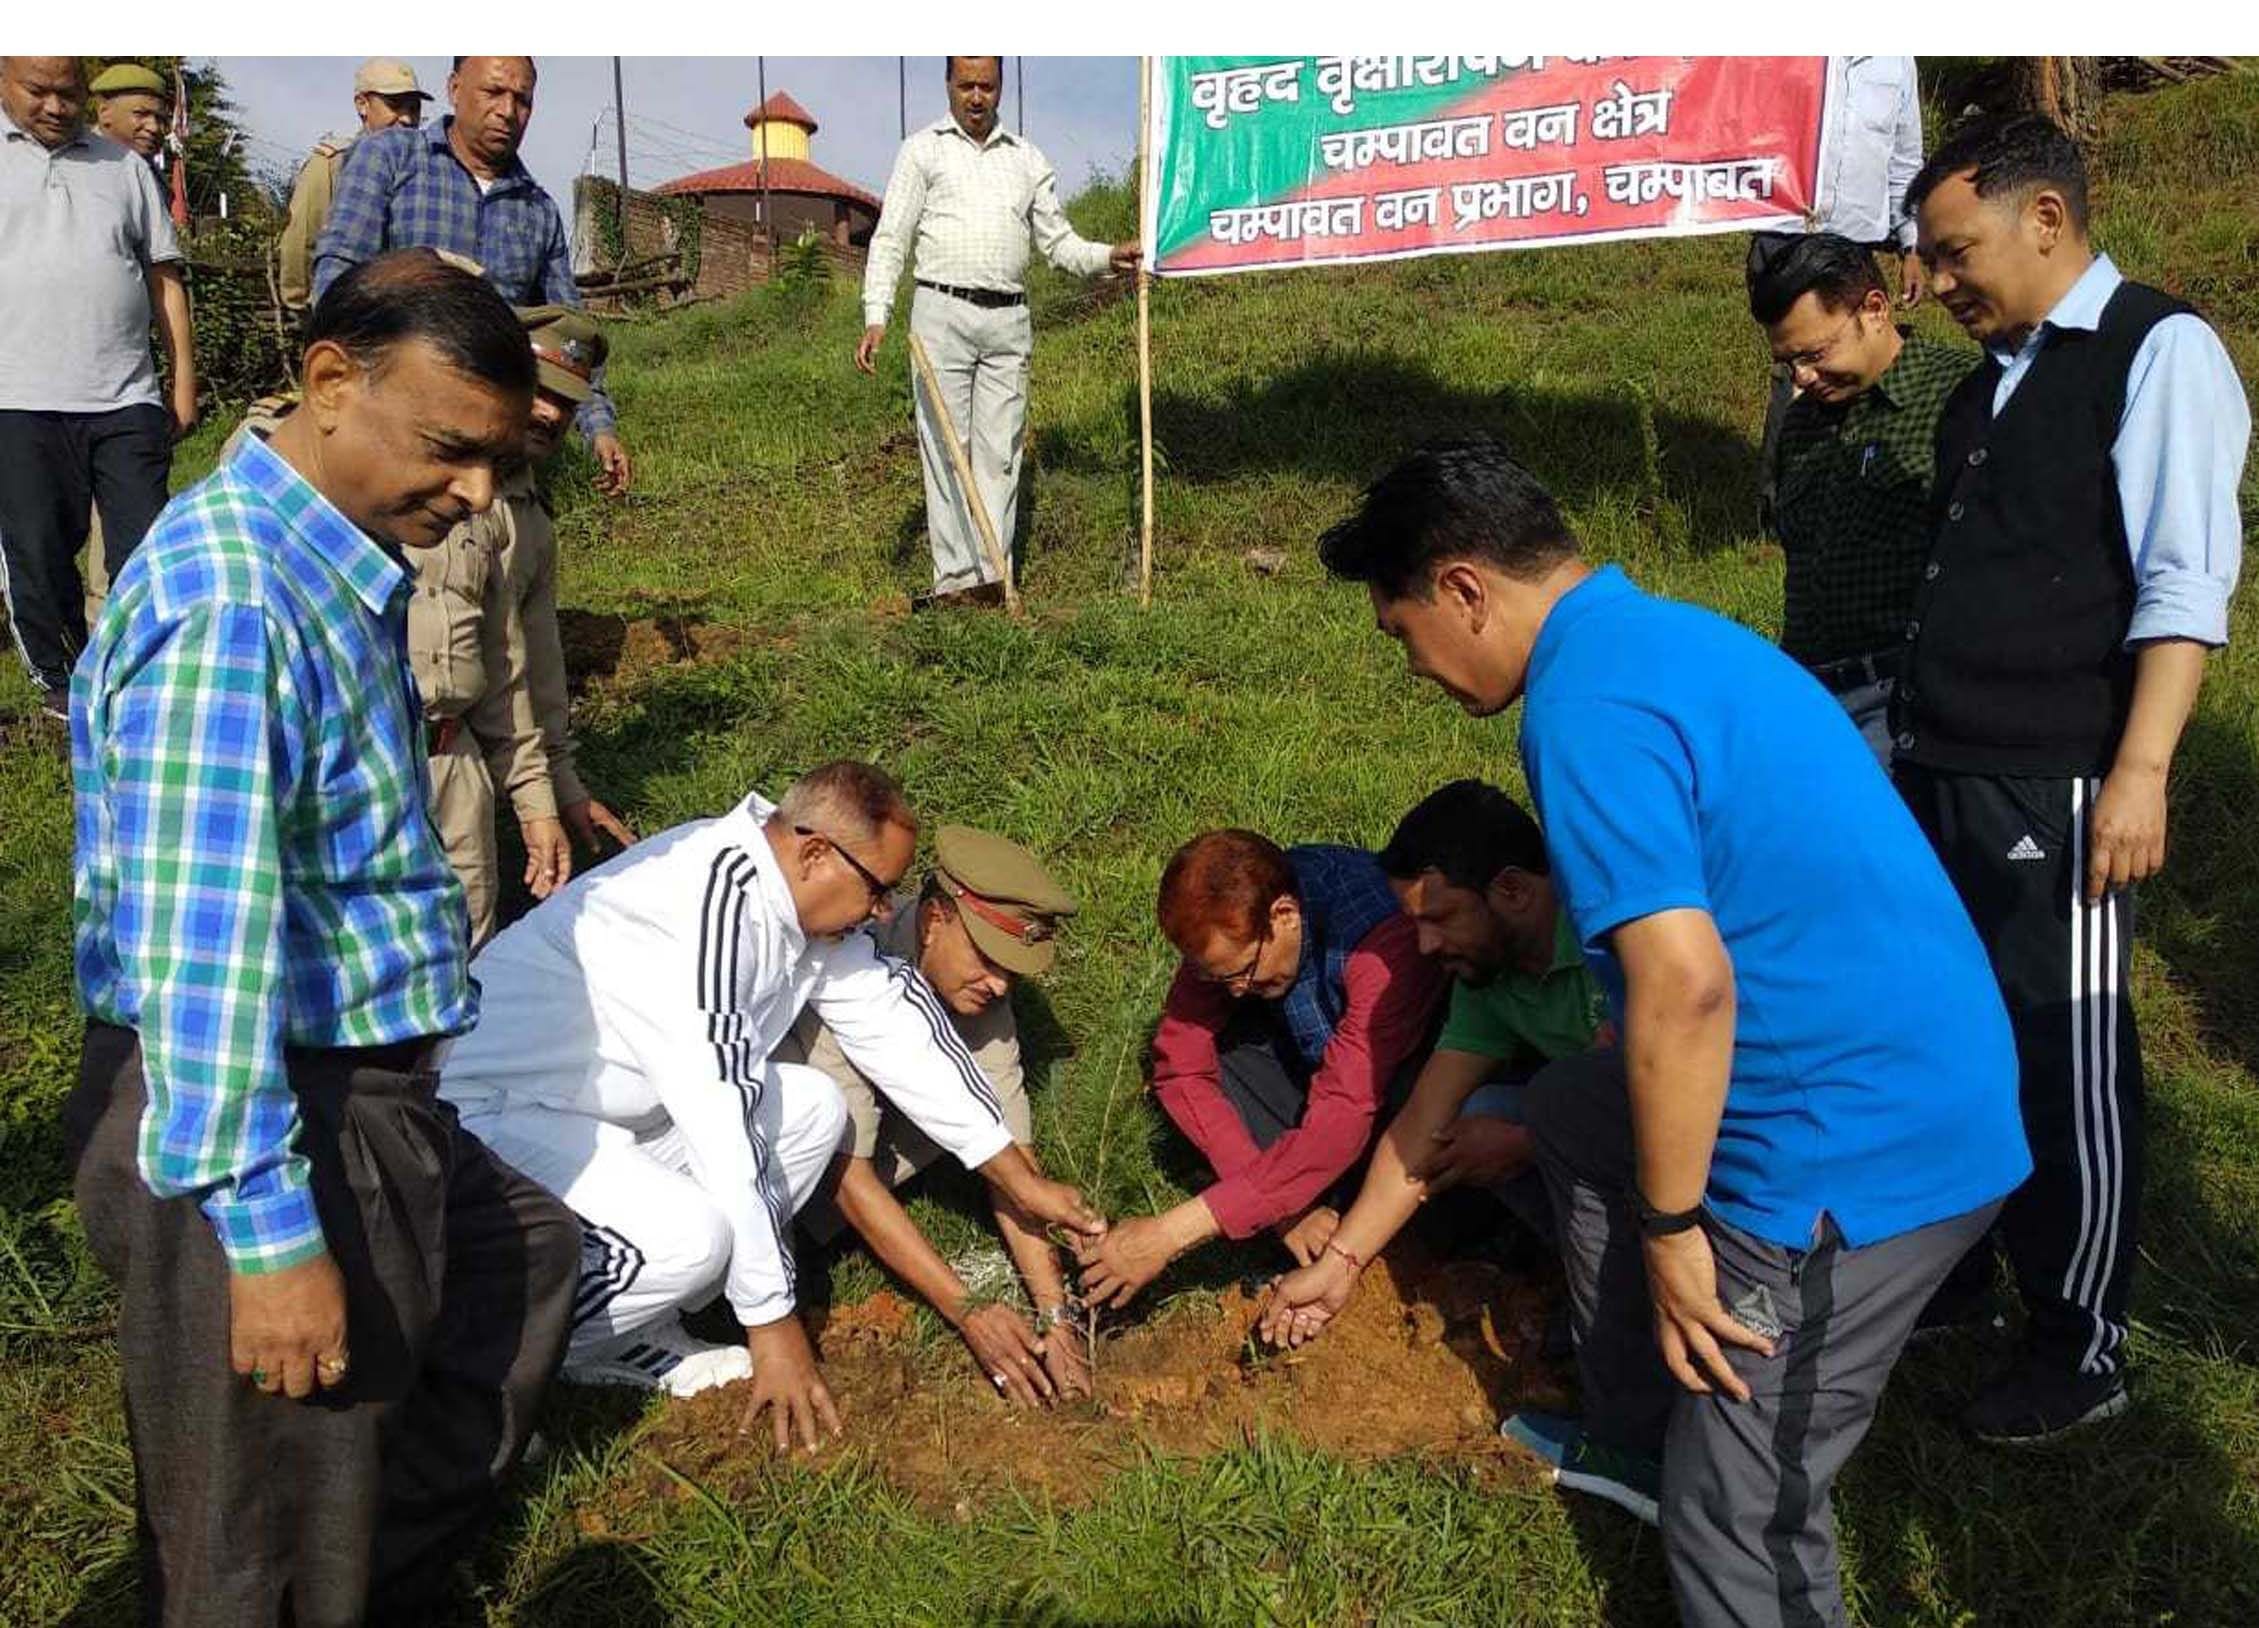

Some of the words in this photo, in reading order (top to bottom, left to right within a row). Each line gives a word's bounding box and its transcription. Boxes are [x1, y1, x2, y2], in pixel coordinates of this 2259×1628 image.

[1191, 61, 1305, 128] वृहद
[1320, 115, 1493, 170] चम्पावत
[1504, 103, 1580, 149] वन
[1591, 78, 1673, 140] क्षेत्र
[1210, 195, 1366, 244] चम्पावत
[1374, 187, 1441, 231] वन
[1452, 171, 1588, 232] प्रभाग,
